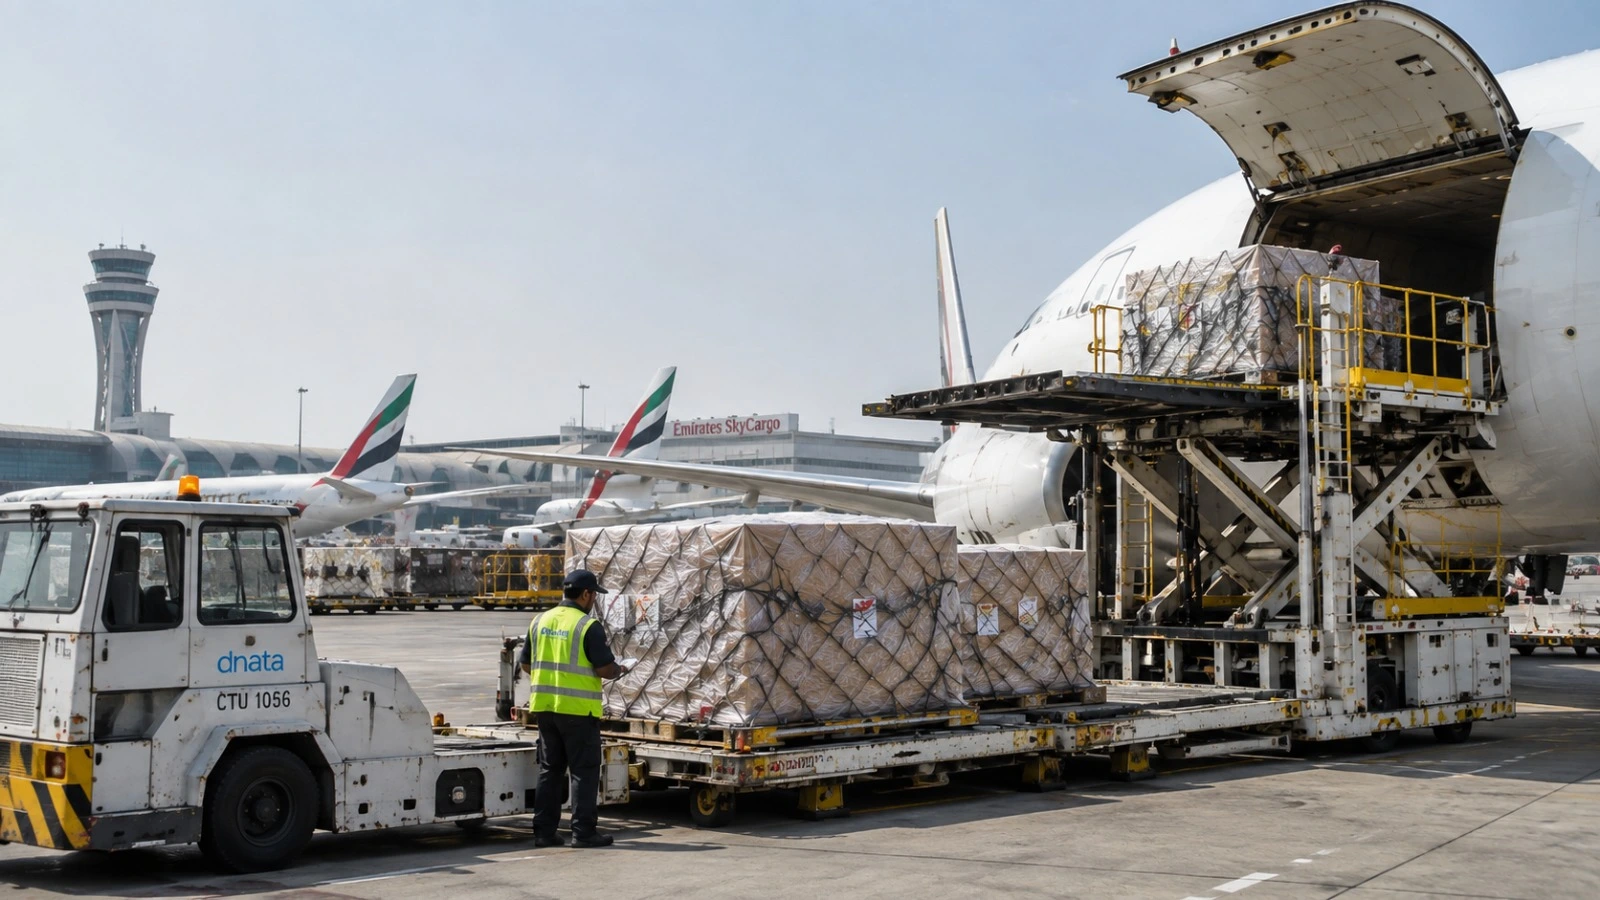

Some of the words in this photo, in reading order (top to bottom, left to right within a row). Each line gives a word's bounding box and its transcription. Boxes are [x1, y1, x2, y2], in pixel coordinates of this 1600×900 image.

[673, 421, 722, 436] Emirates
[725, 417, 781, 435] SkyCargo
[217, 650, 284, 673] dnata
[217, 692, 248, 711] CTU
[256, 690, 291, 709] 1056
